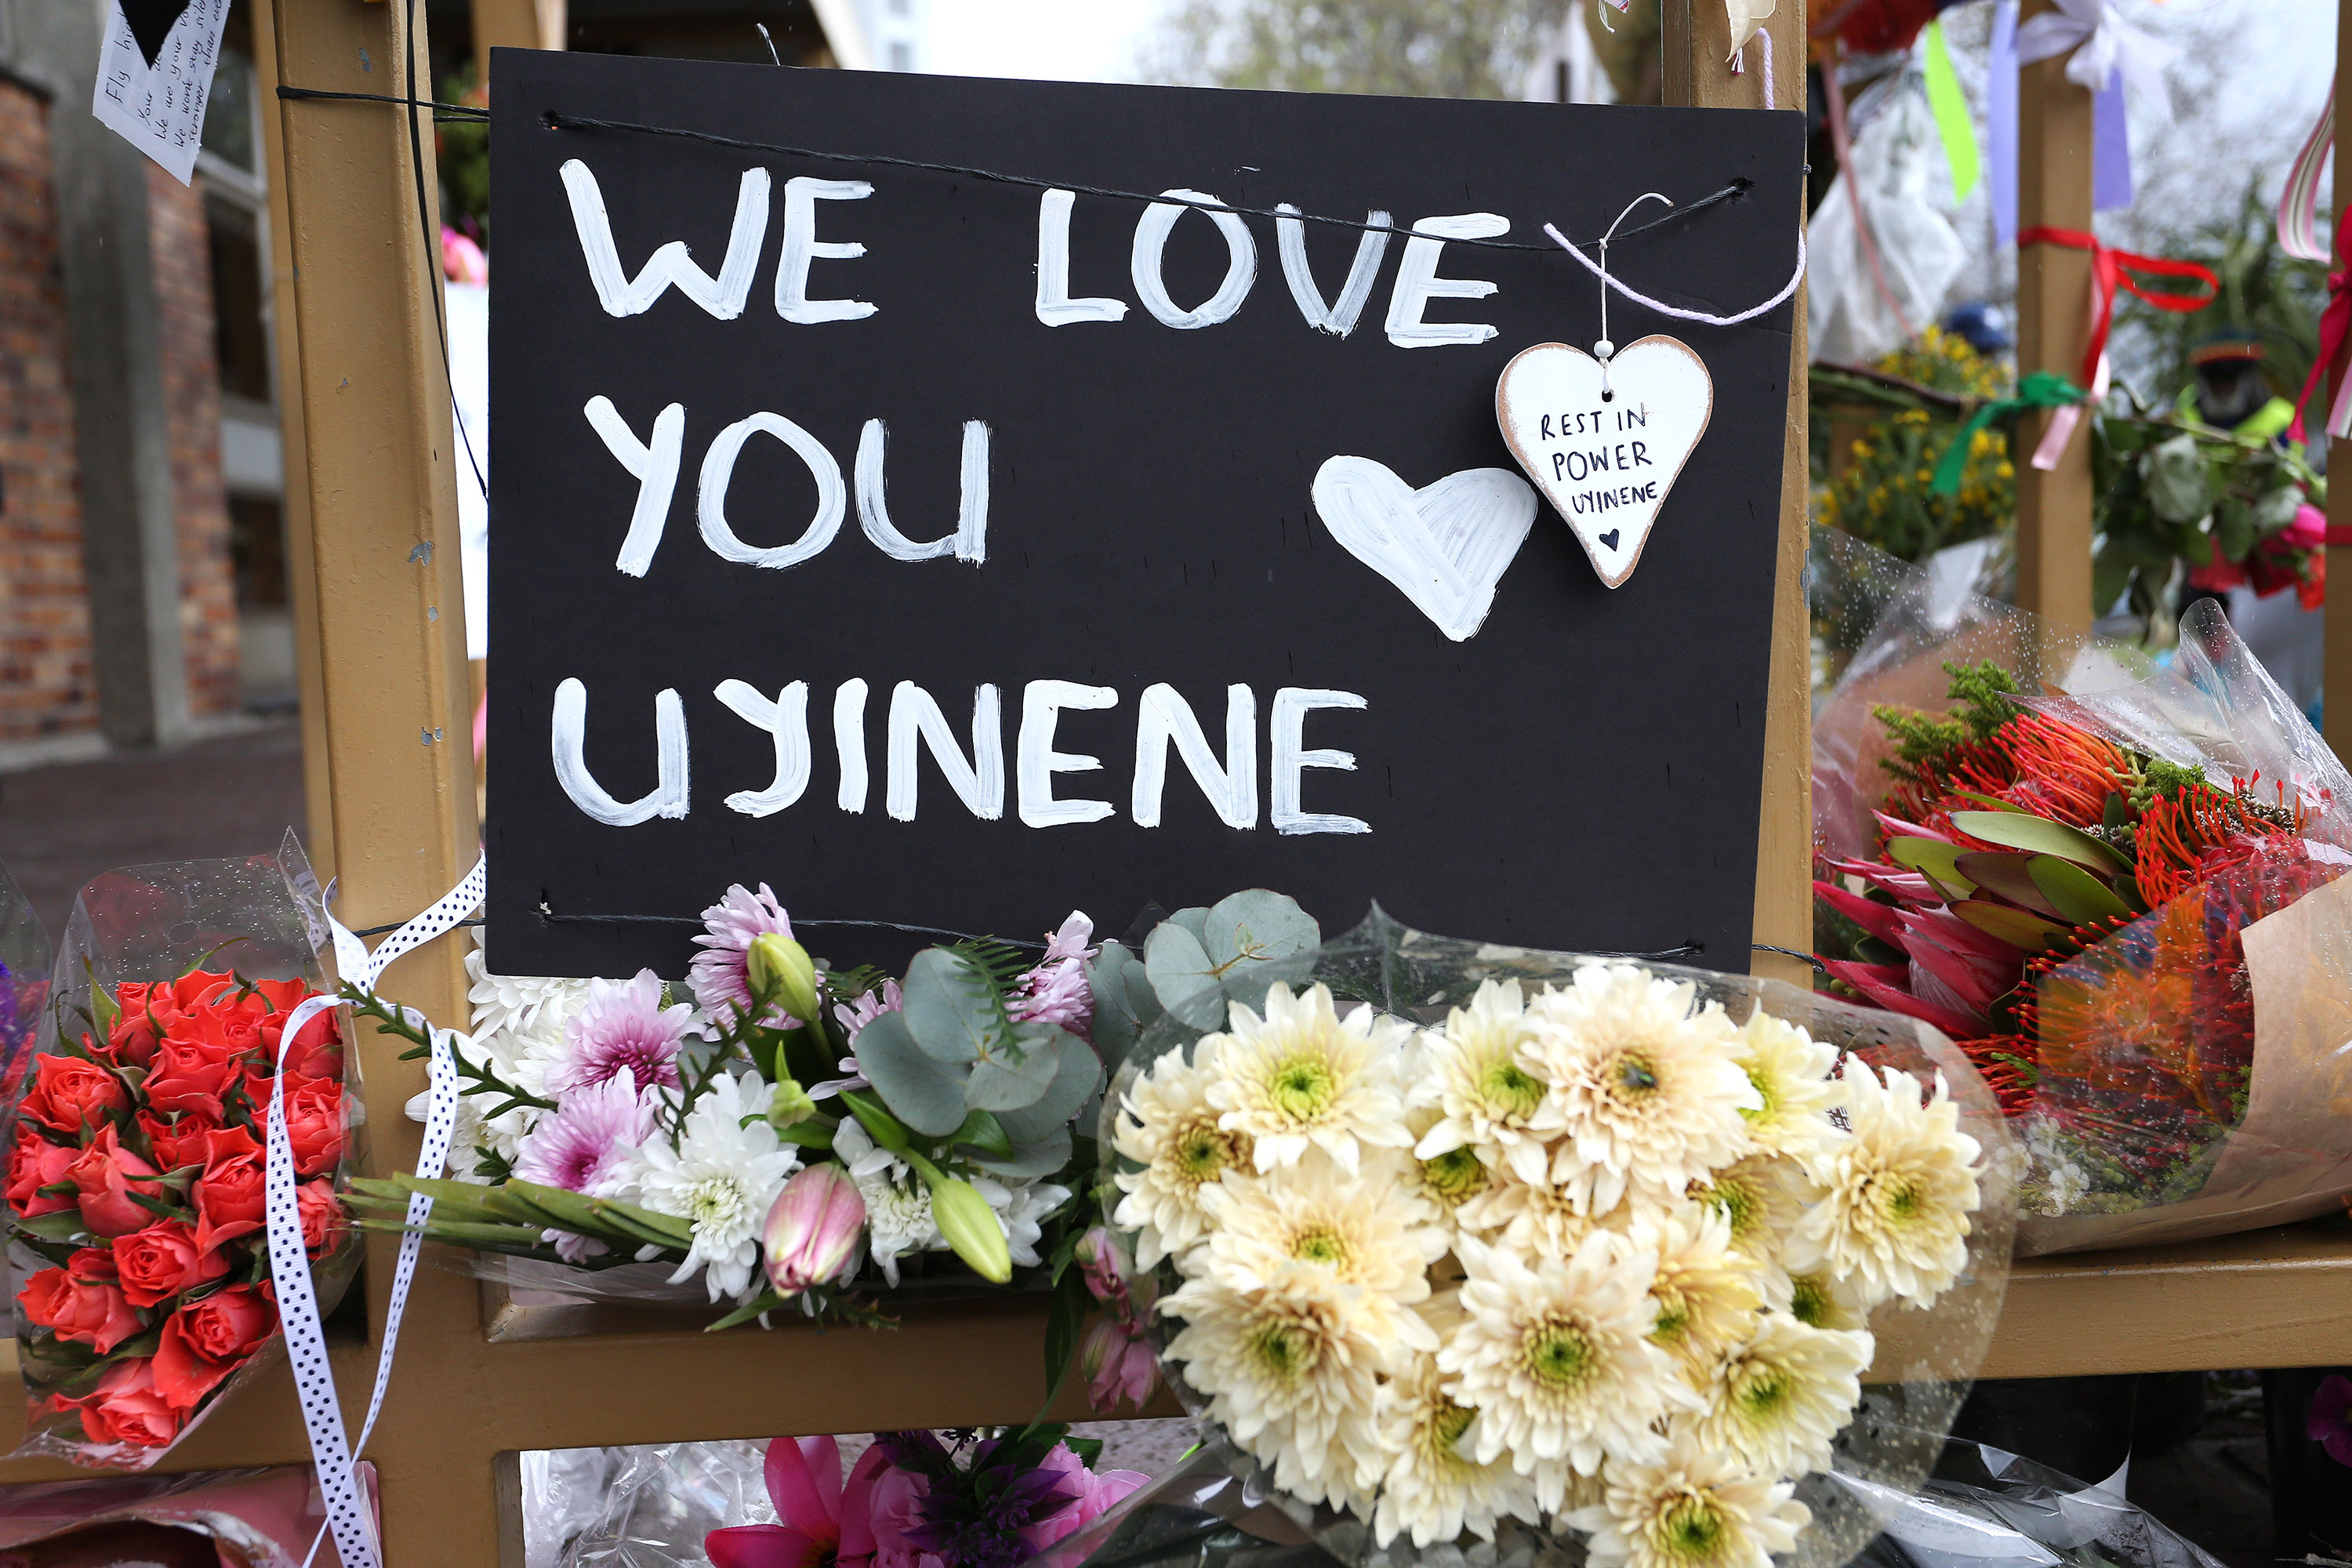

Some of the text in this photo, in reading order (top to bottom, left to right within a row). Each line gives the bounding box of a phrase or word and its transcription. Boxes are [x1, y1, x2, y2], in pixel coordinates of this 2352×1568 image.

[105, 12, 133, 104] Fly hi
[154, 119, 169, 140] We
[165, 85, 174, 109] are
[170, 34, 182, 81] your
[174, 129, 187, 147] We
[189, 39, 204, 74] stay
[189, 79, 204, 144] stronger
[203, 31, 216, 67] than
[559, 158, 1511, 348] WE LOVE
[1541, 401, 1646, 441] REST IN
[1552, 441, 1653, 482] POWER
[583, 394, 991, 579] YOU
[1571, 481, 1658, 514] UYINENE
[551, 677, 1374, 837] UYINENE
